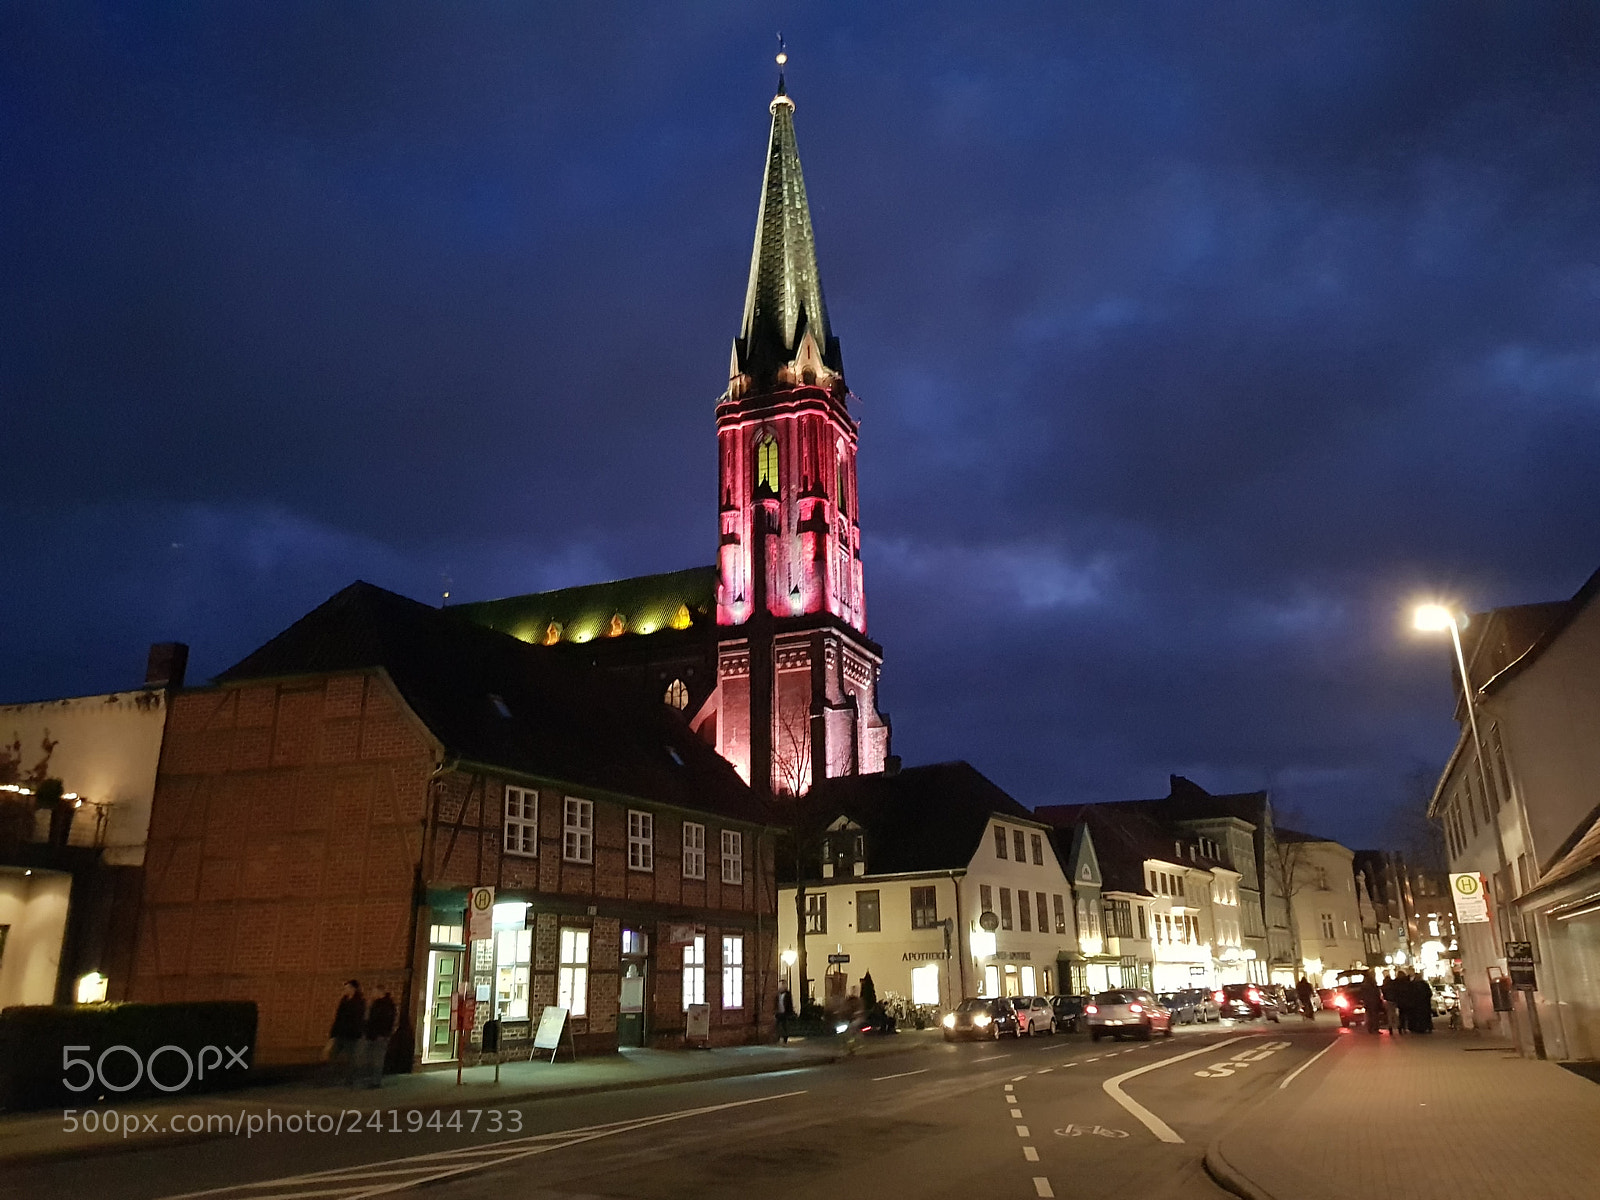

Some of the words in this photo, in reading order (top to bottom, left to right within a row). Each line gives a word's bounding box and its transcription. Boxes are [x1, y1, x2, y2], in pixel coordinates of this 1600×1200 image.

[1461, 878, 1472, 891] H
[479, 893, 487, 906] H
[1194, 1041, 1293, 1078] BUS
